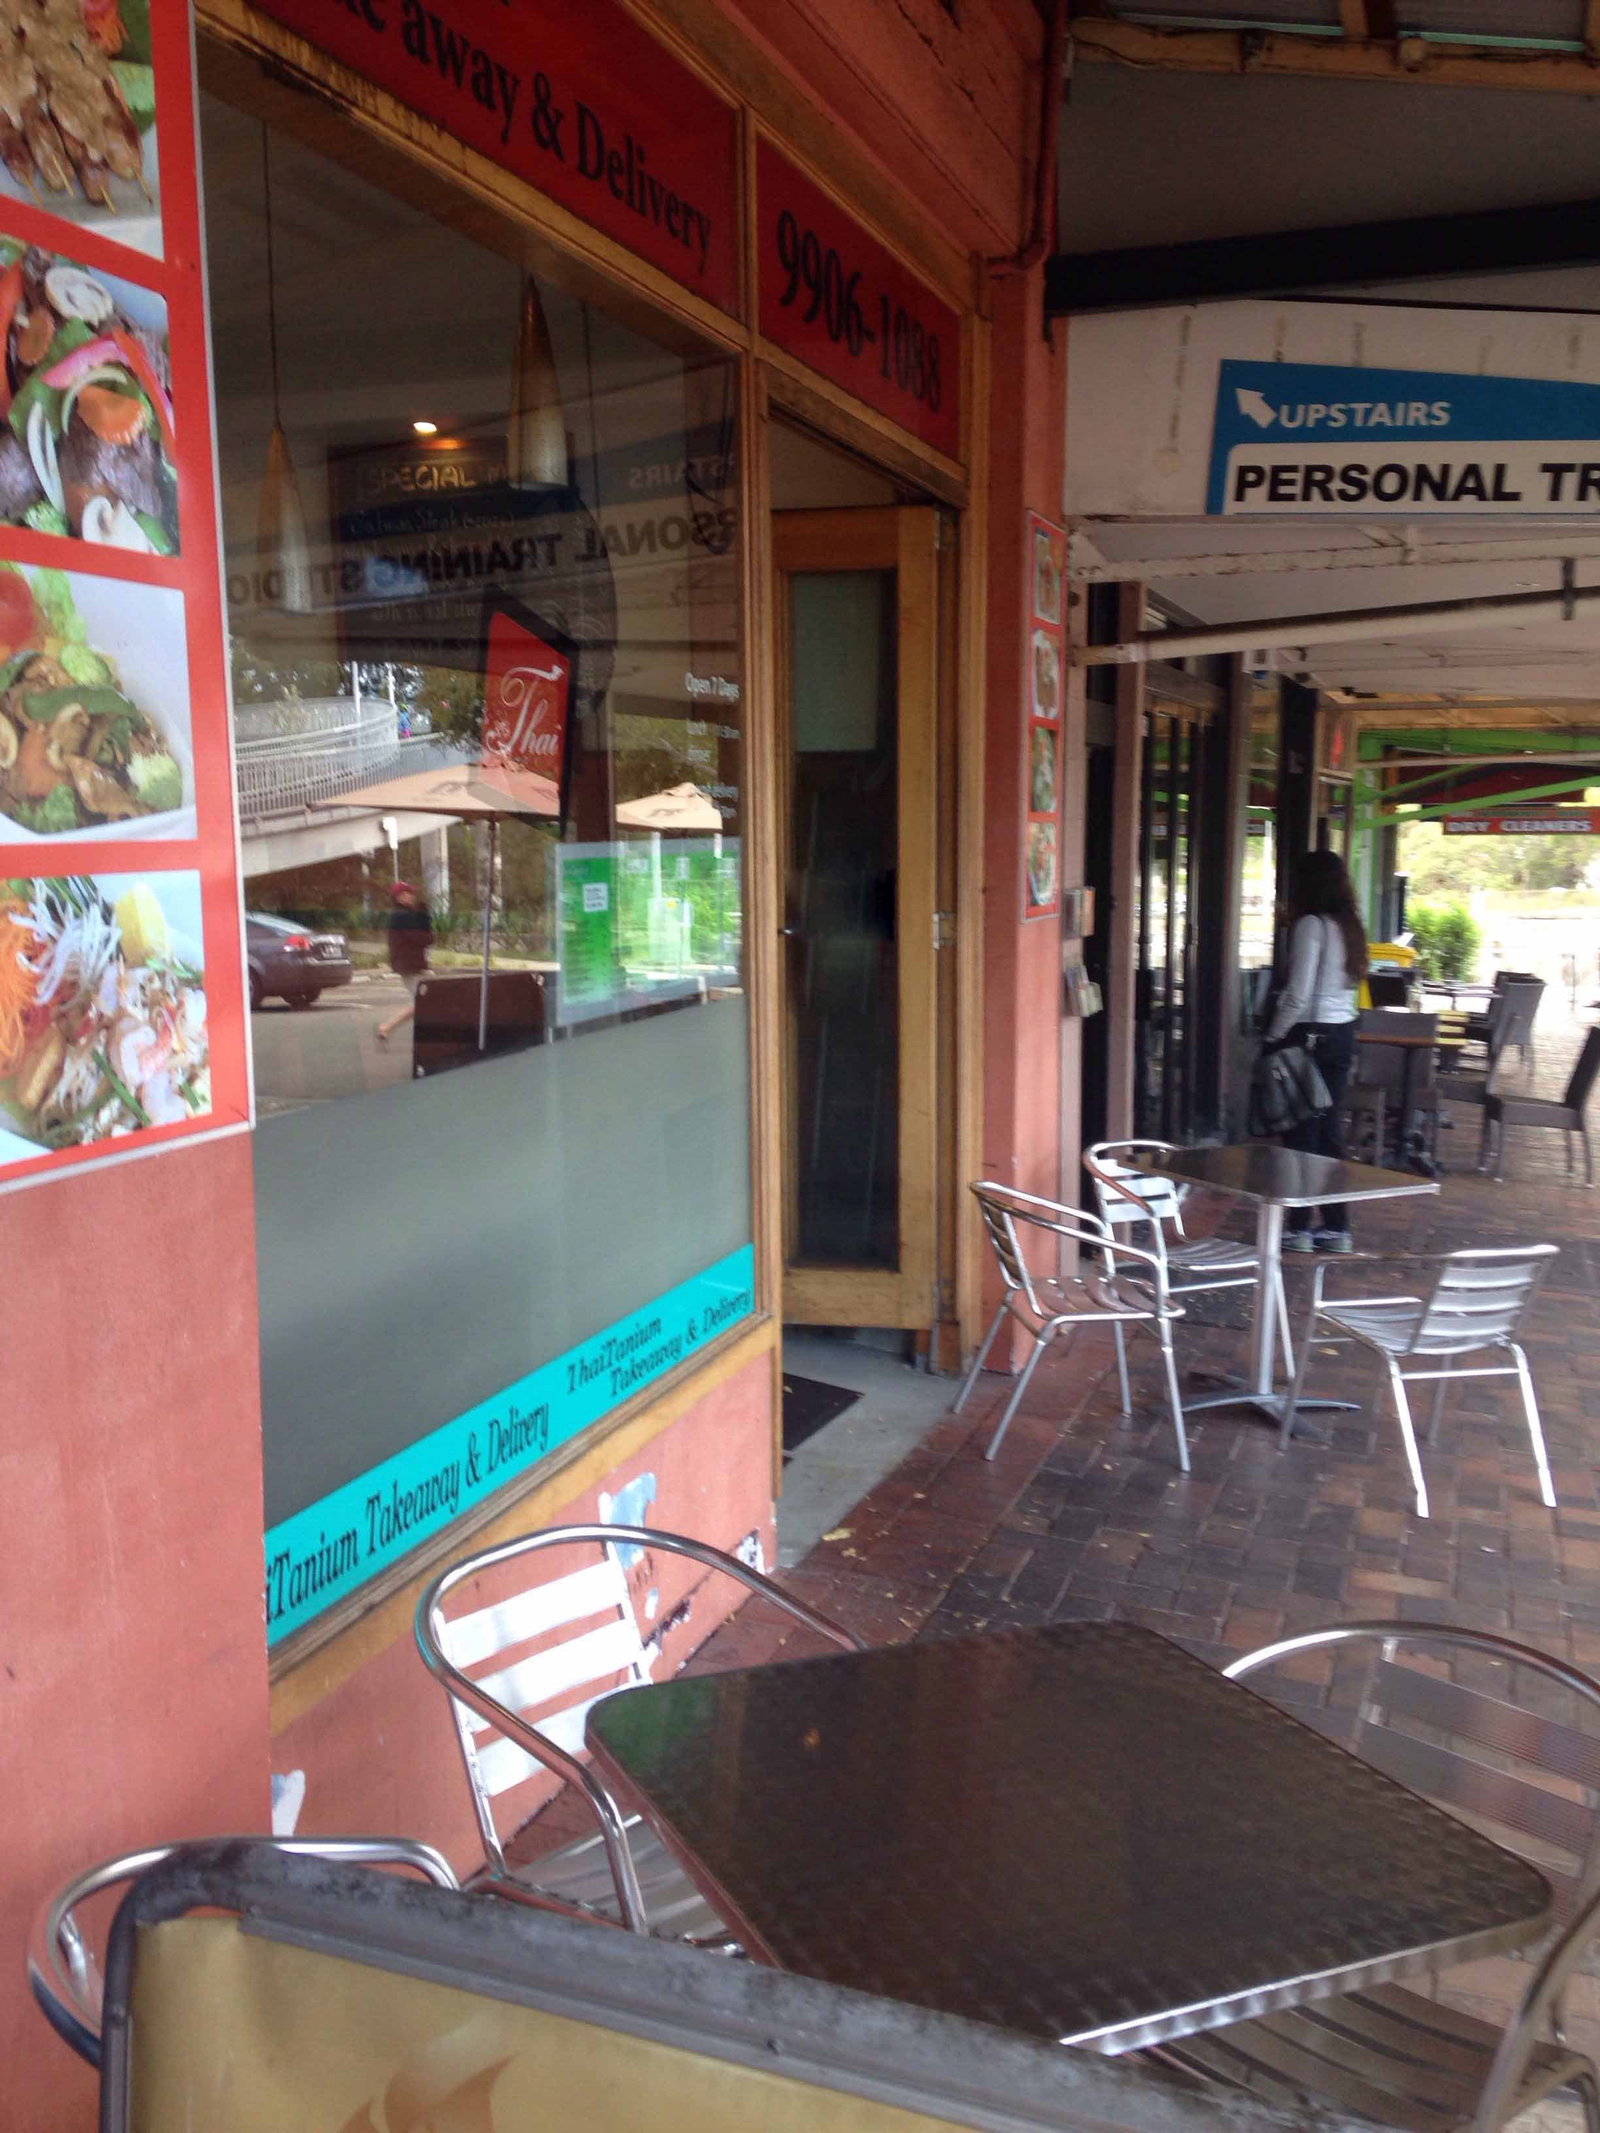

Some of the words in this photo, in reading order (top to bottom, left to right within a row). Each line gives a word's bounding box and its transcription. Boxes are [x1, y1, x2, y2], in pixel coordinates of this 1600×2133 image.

[402, 0, 520, 144] away
[531, 71, 564, 161] &
[576, 101, 712, 275] Delivery
[776, 209, 942, 414] 9906-1088
[1278, 400, 1451, 429] UPSTAIRS
[1233, 463, 1522, 503] PERSONAL
[1540, 463, 1600, 502] TR
[486, 664, 565, 757] Thai
[1500, 820, 1592, 832] CLEANERS
[567, 1317, 662, 1394] ThaiTanium
[610, 1335, 684, 1398] Takeaway
[686, 1319, 698, 1343] &
[703, 1288, 752, 1333] Delivery
[365, 1458, 461, 1557] Takeaway
[465, 1432, 481, 1488] &
[487, 1401, 550, 1474] Delivery
